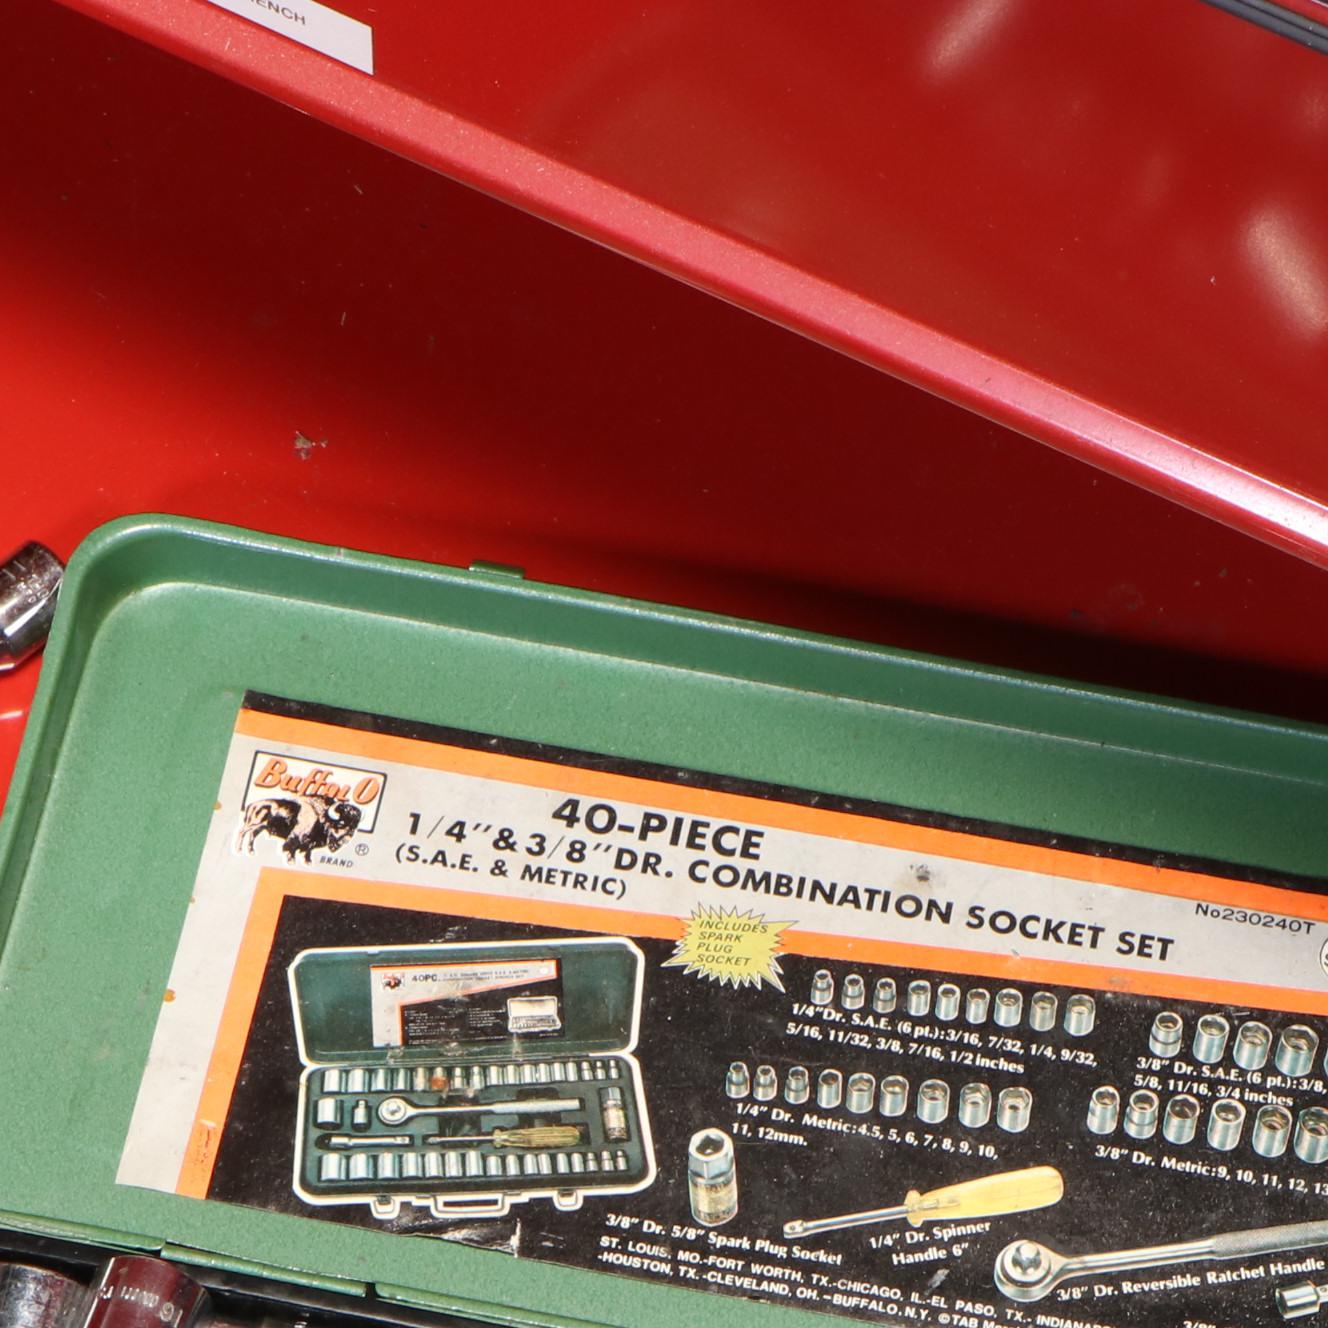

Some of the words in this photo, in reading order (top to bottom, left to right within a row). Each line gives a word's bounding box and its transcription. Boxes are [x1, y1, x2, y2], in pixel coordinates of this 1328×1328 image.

[251, 0, 306, 25] ENCH
[552, 798, 765, 860] 40-PIECE
[320, 855, 354, 868] BRAND
[394, 841, 478, 873] (S.A.E.
[490, 859, 509, 877] &
[520, 863, 627, 900] METRIC)
[688, 859, 953, 924] COMBINATION
[966, 905, 1105, 949] SOCKET
[1116, 931, 1175, 961] SET
[698, 931, 743, 943] SPARK
[699, 920, 769, 934] INCLUDES
[696, 942, 734, 954] PLUG
[696, 954, 752, 967] SOCKET
[786, 1022, 822, 1040] 5/16,
[829, 1030, 872, 1050] 11/32,
[875, 1039, 905, 1055] 3/8,
[908, 1043, 945, 1062] 7/16,
[950, 1049, 973, 1065] 1/2
[975, 1055, 1025, 1074] inches
[851, 1013, 892, 1031] S.A.E.
[988, 1034, 1025, 1055] 7/32,
[1030, 1043, 1056, 1060] 1/4,
[1060, 1048, 1098, 1067] 9/32,
[1173, 1061, 1198, 1077] Dr.
[1201, 1066, 1243, 1082] S.A.E.
[1133, 1074, 1163, 1091] 5/8,
[1167, 1078, 1211, 1098] 11/16,
[1216, 1083, 1240, 1099] 3/4
[1243, 1089, 1294, 1108] inches
[732, 1122, 752, 1138] 11,
[757, 1126, 808, 1146] 12mm.
[771, 1107, 795, 1123] Dr.
[887, 1129, 901, 1142] 5,
[904, 1131, 919, 1146] 6,
[923, 1134, 938, 1149] 7,
[941, 1138, 955, 1153] 8,
[959, 1141, 972, 1155] 9,
[978, 1144, 999, 1160] 10,
[1131, 1151, 1156, 1168] Dr.
[1236, 1168, 1257, 1185] 10,
[1262, 1173, 1283, 1189] 11,
[1288, 1177, 1309, 1194] 12,
[600, 1235, 622, 1250] ST.
[642, 1220, 666, 1236] Dr.
[707, 1231, 751, 1251] Spark
[754, 1238, 788, 1259] Plug
[791, 1245, 843, 1266] Socket
[905, 1228, 930, 1245] Dr.
[932, 1220, 992, 1244] Spinner
[892, 1247, 947, 1266] Handle
[1094, 1281, 1118, 1298] Dr.
[1122, 1272, 1202, 1294] Reversible
[1206, 1265, 1265, 1286] Ratchet
[1270, 1259, 1326, 1276] Handle
[796, 1287, 820, 1301] OH.
